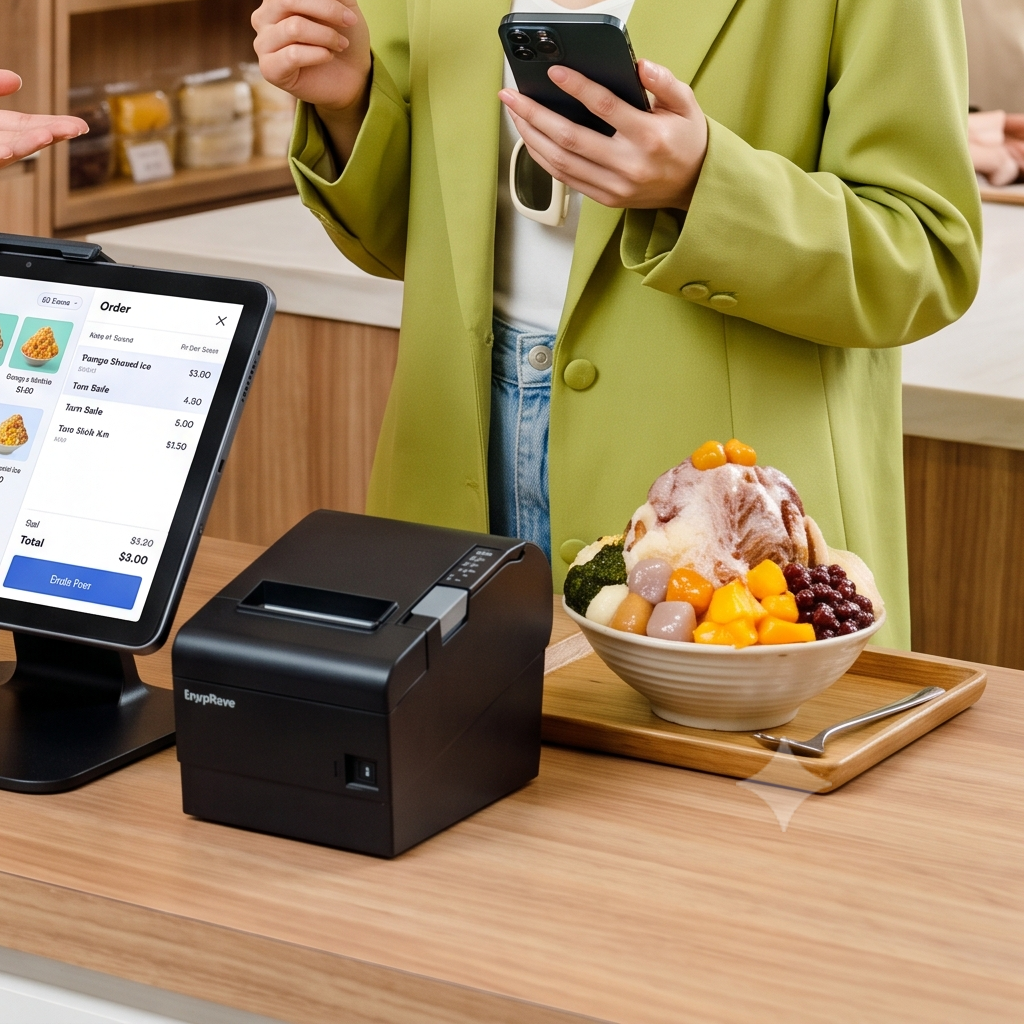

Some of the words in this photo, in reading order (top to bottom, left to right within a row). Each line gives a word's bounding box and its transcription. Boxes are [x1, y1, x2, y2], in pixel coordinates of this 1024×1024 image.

[100, 301, 131, 314] Order
[20, 535, 45, 548] Total
[119, 551, 148, 565] $3.00
